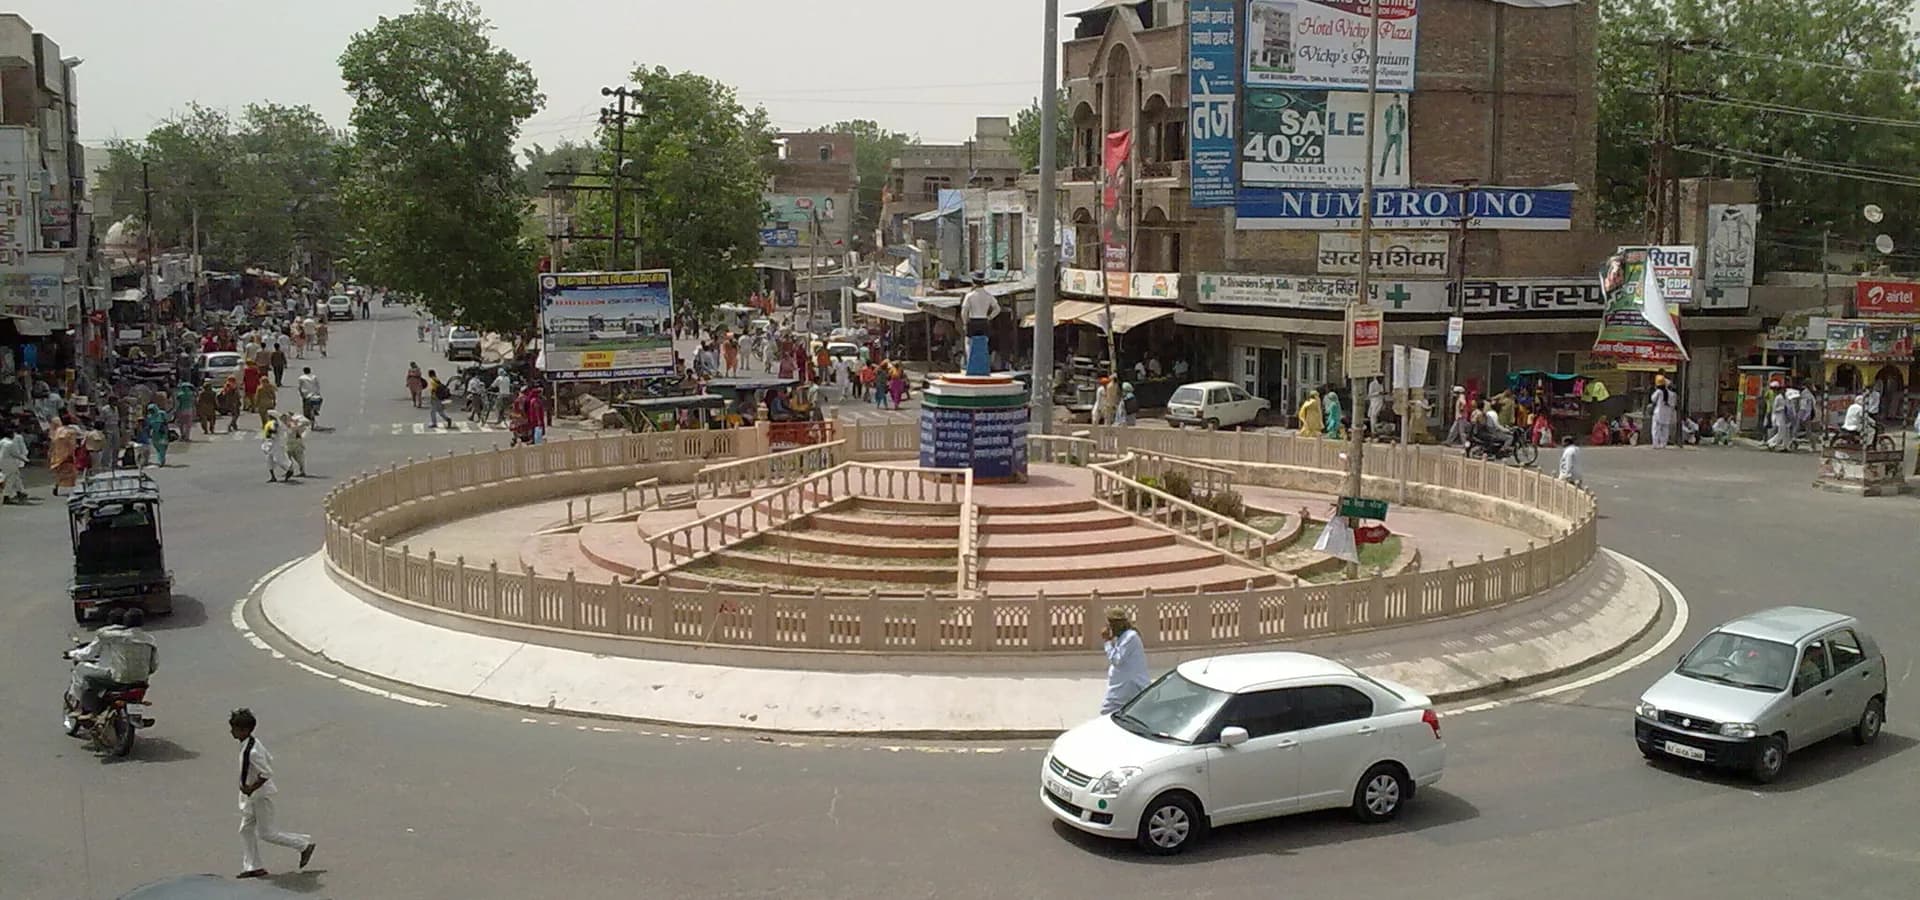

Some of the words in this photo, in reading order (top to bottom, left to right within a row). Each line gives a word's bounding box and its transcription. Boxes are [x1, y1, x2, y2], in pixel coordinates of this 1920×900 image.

[1298, 15, 1333, 37] Hotel
[1335, 18, 1369, 42] Vicky
[1378, 21, 1412, 40] Plaza
[1299, 46, 1348, 68] Vicky's
[1352, 48, 1409, 66] Prmium
[1192, 74, 1235, 139] तेज
[1280, 109, 1365, 136] SALE
[1243, 134, 1321, 163] 40%
[1271, 164, 1334, 174] NUMERO
[1280, 191, 1449, 217] NUMERO
[1458, 192, 1532, 217] UNO
[1530, 284, 1605, 308] हस्प
[1886, 290, 1913, 303] airtel
